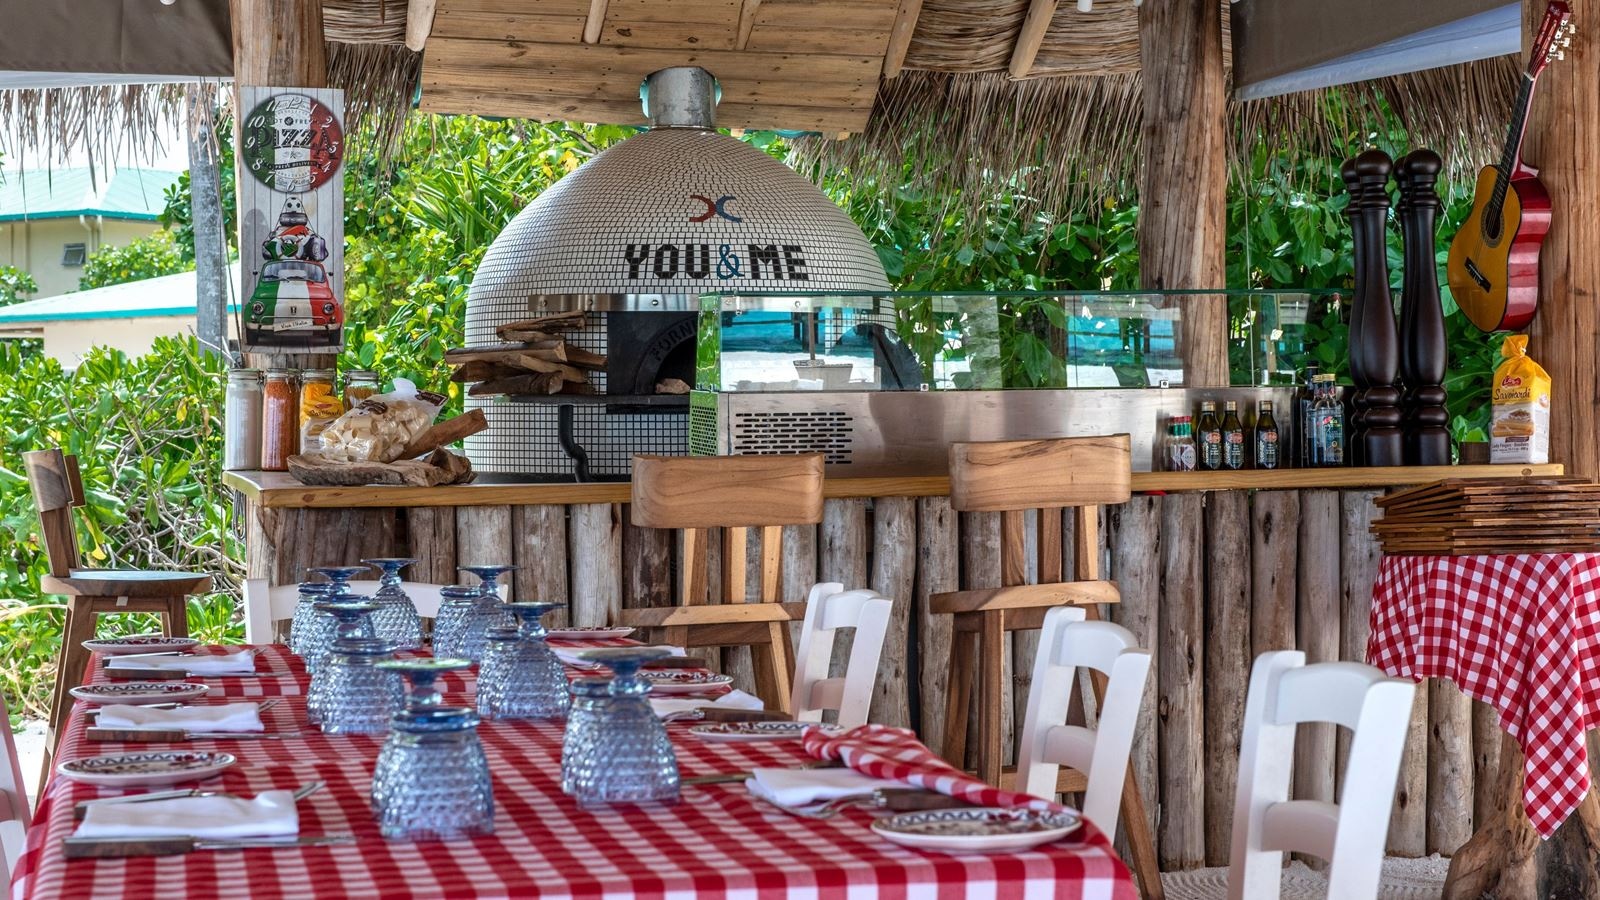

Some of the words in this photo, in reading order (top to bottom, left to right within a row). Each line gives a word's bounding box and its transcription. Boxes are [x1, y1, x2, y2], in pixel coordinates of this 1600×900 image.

[266, 100, 280, 112] 11
[286, 97, 302, 110] 12
[310, 103, 318, 115] 1
[248, 115, 265, 128] 10
[321, 115, 333, 128] 2
[245, 136, 255, 149] 9
[250, 126, 339, 160] PIZZA
[328, 141, 339, 154] 3
[252, 158, 263, 170] 8
[322, 161, 332, 173] 4
[265, 171, 276, 183] 7
[310, 171, 318, 183] 5
[286, 179, 296, 192] 6
[1494, 388, 1531, 400] Savoiardi
